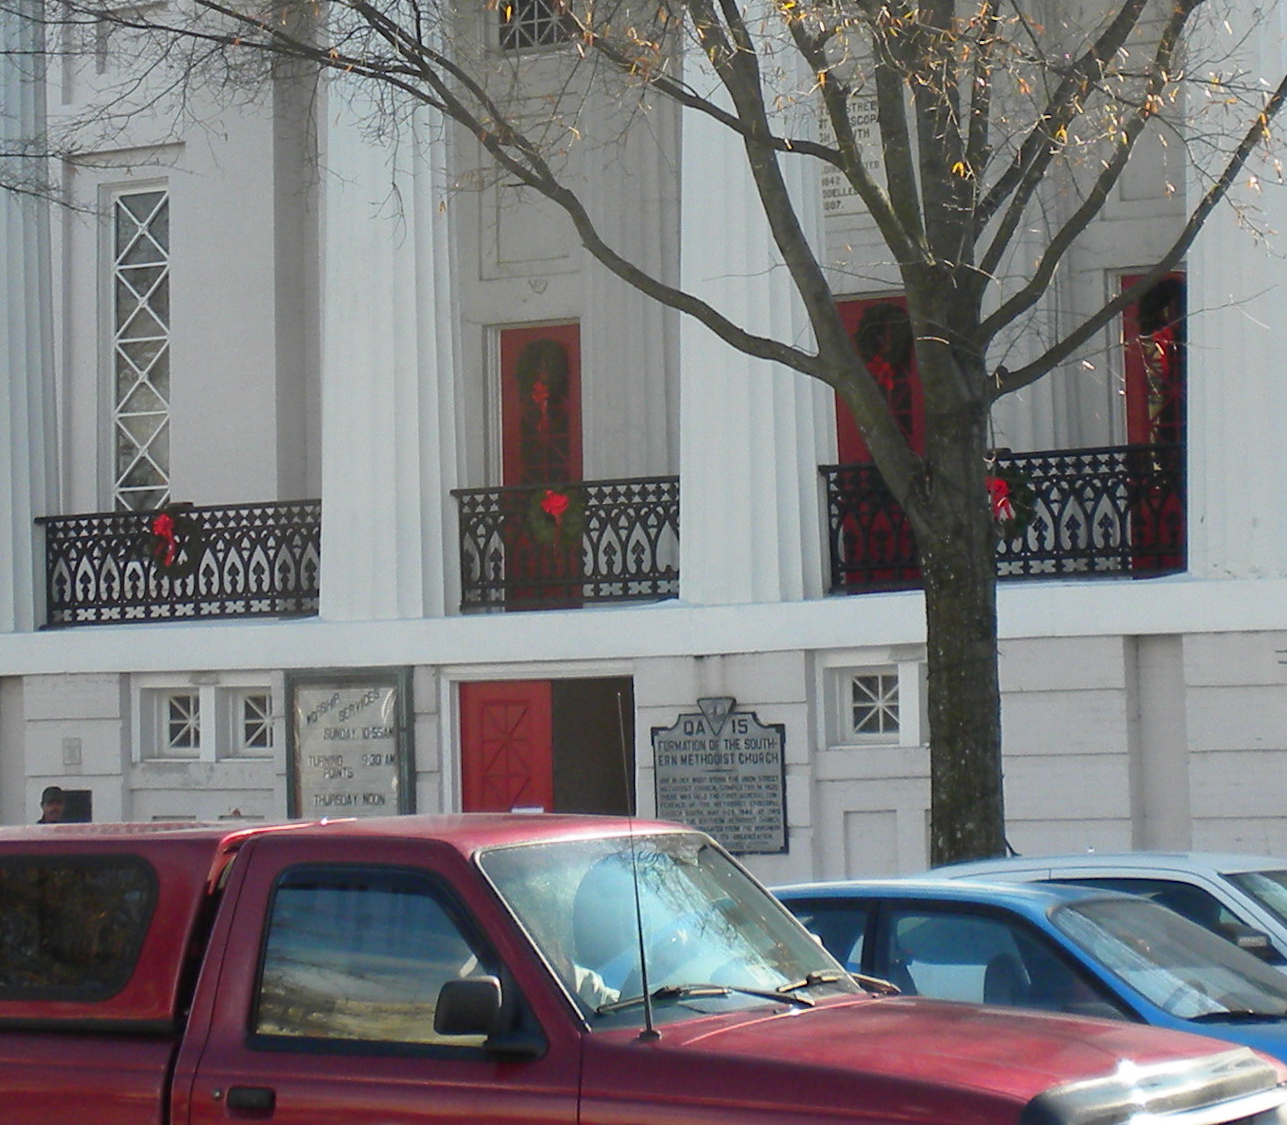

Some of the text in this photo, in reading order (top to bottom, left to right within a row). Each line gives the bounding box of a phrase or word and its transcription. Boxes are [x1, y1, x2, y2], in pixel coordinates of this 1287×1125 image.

[306, 692, 340, 725] WORSHIP
[338, 689, 380, 722] SERVICES
[324, 727, 357, 740] SUNDAY
[684, 719, 748, 736] QA 15
[658, 737, 778, 752] FORMATION OF THE SOUTH-
[658, 752, 779, 766] ERN METHODIST CHURCH
[313, 792, 386, 806] THURSDAY NOON
